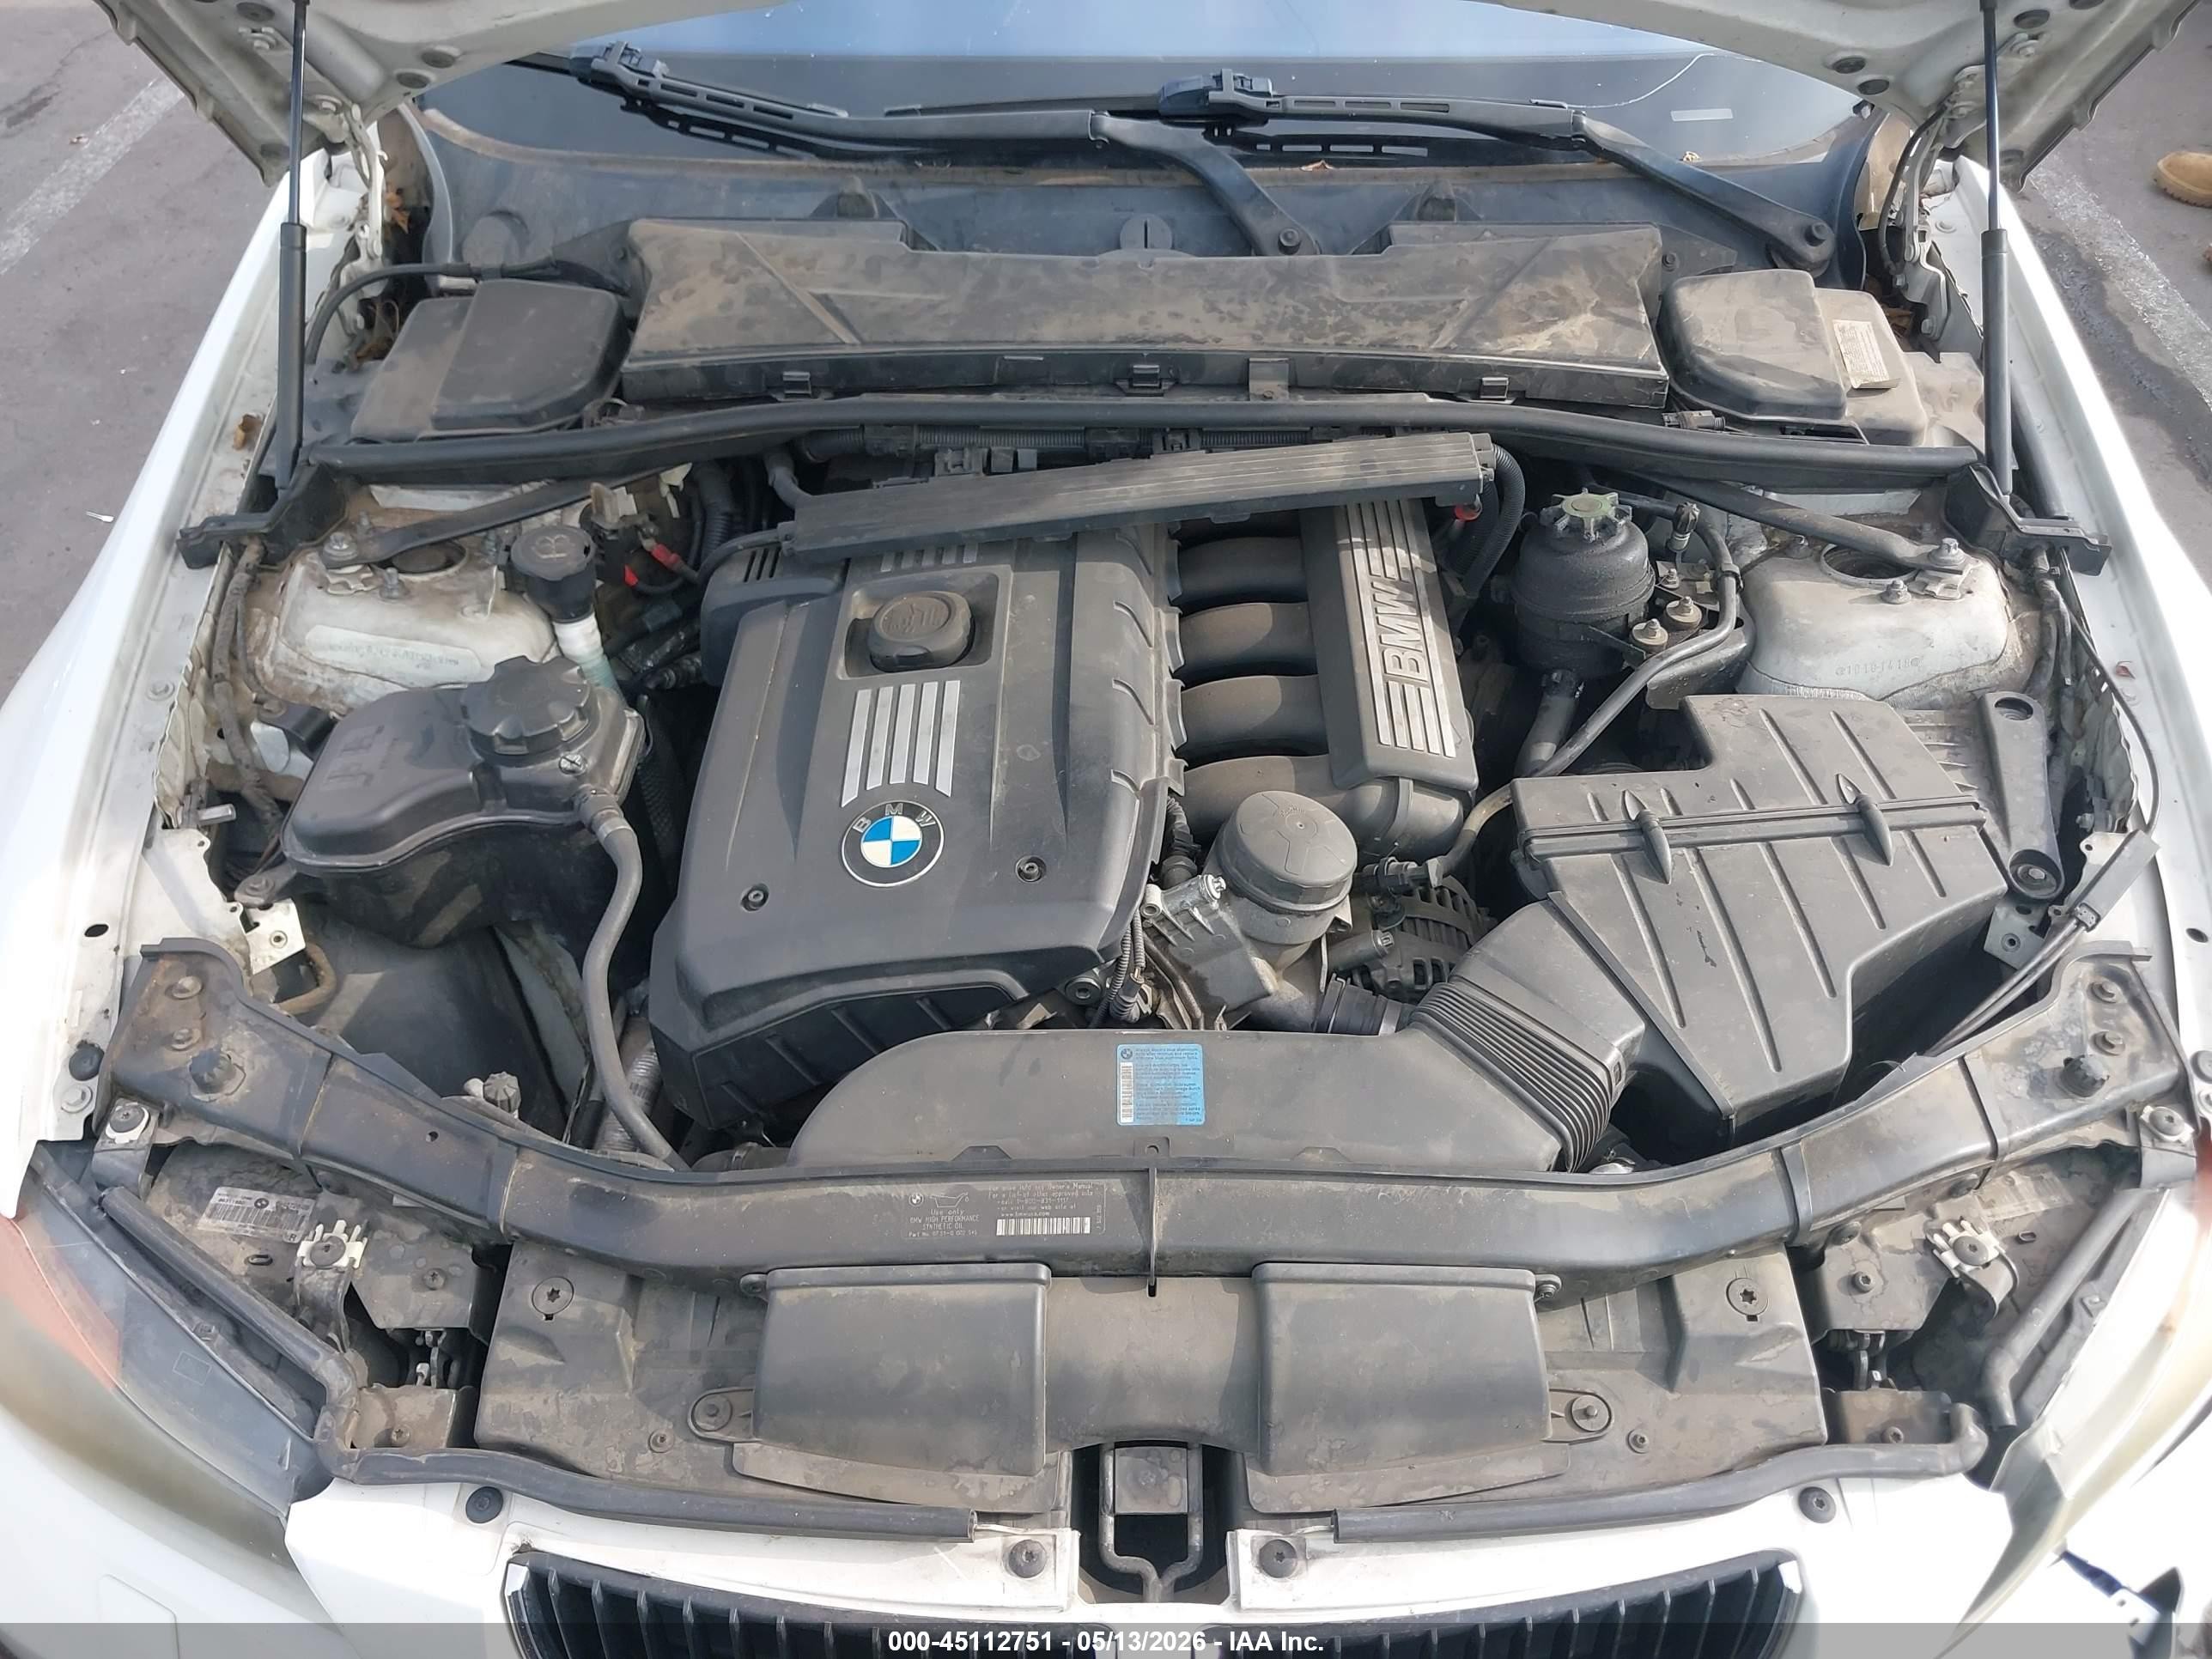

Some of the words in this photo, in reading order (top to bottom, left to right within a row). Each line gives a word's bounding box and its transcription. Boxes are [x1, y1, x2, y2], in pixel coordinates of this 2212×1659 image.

[1372, 581, 1429, 682] BMW
[853, 802, 936, 833] BMW
[940, 1214, 980, 1223] PERFORMANCE
[948, 1207, 964, 1217] only
